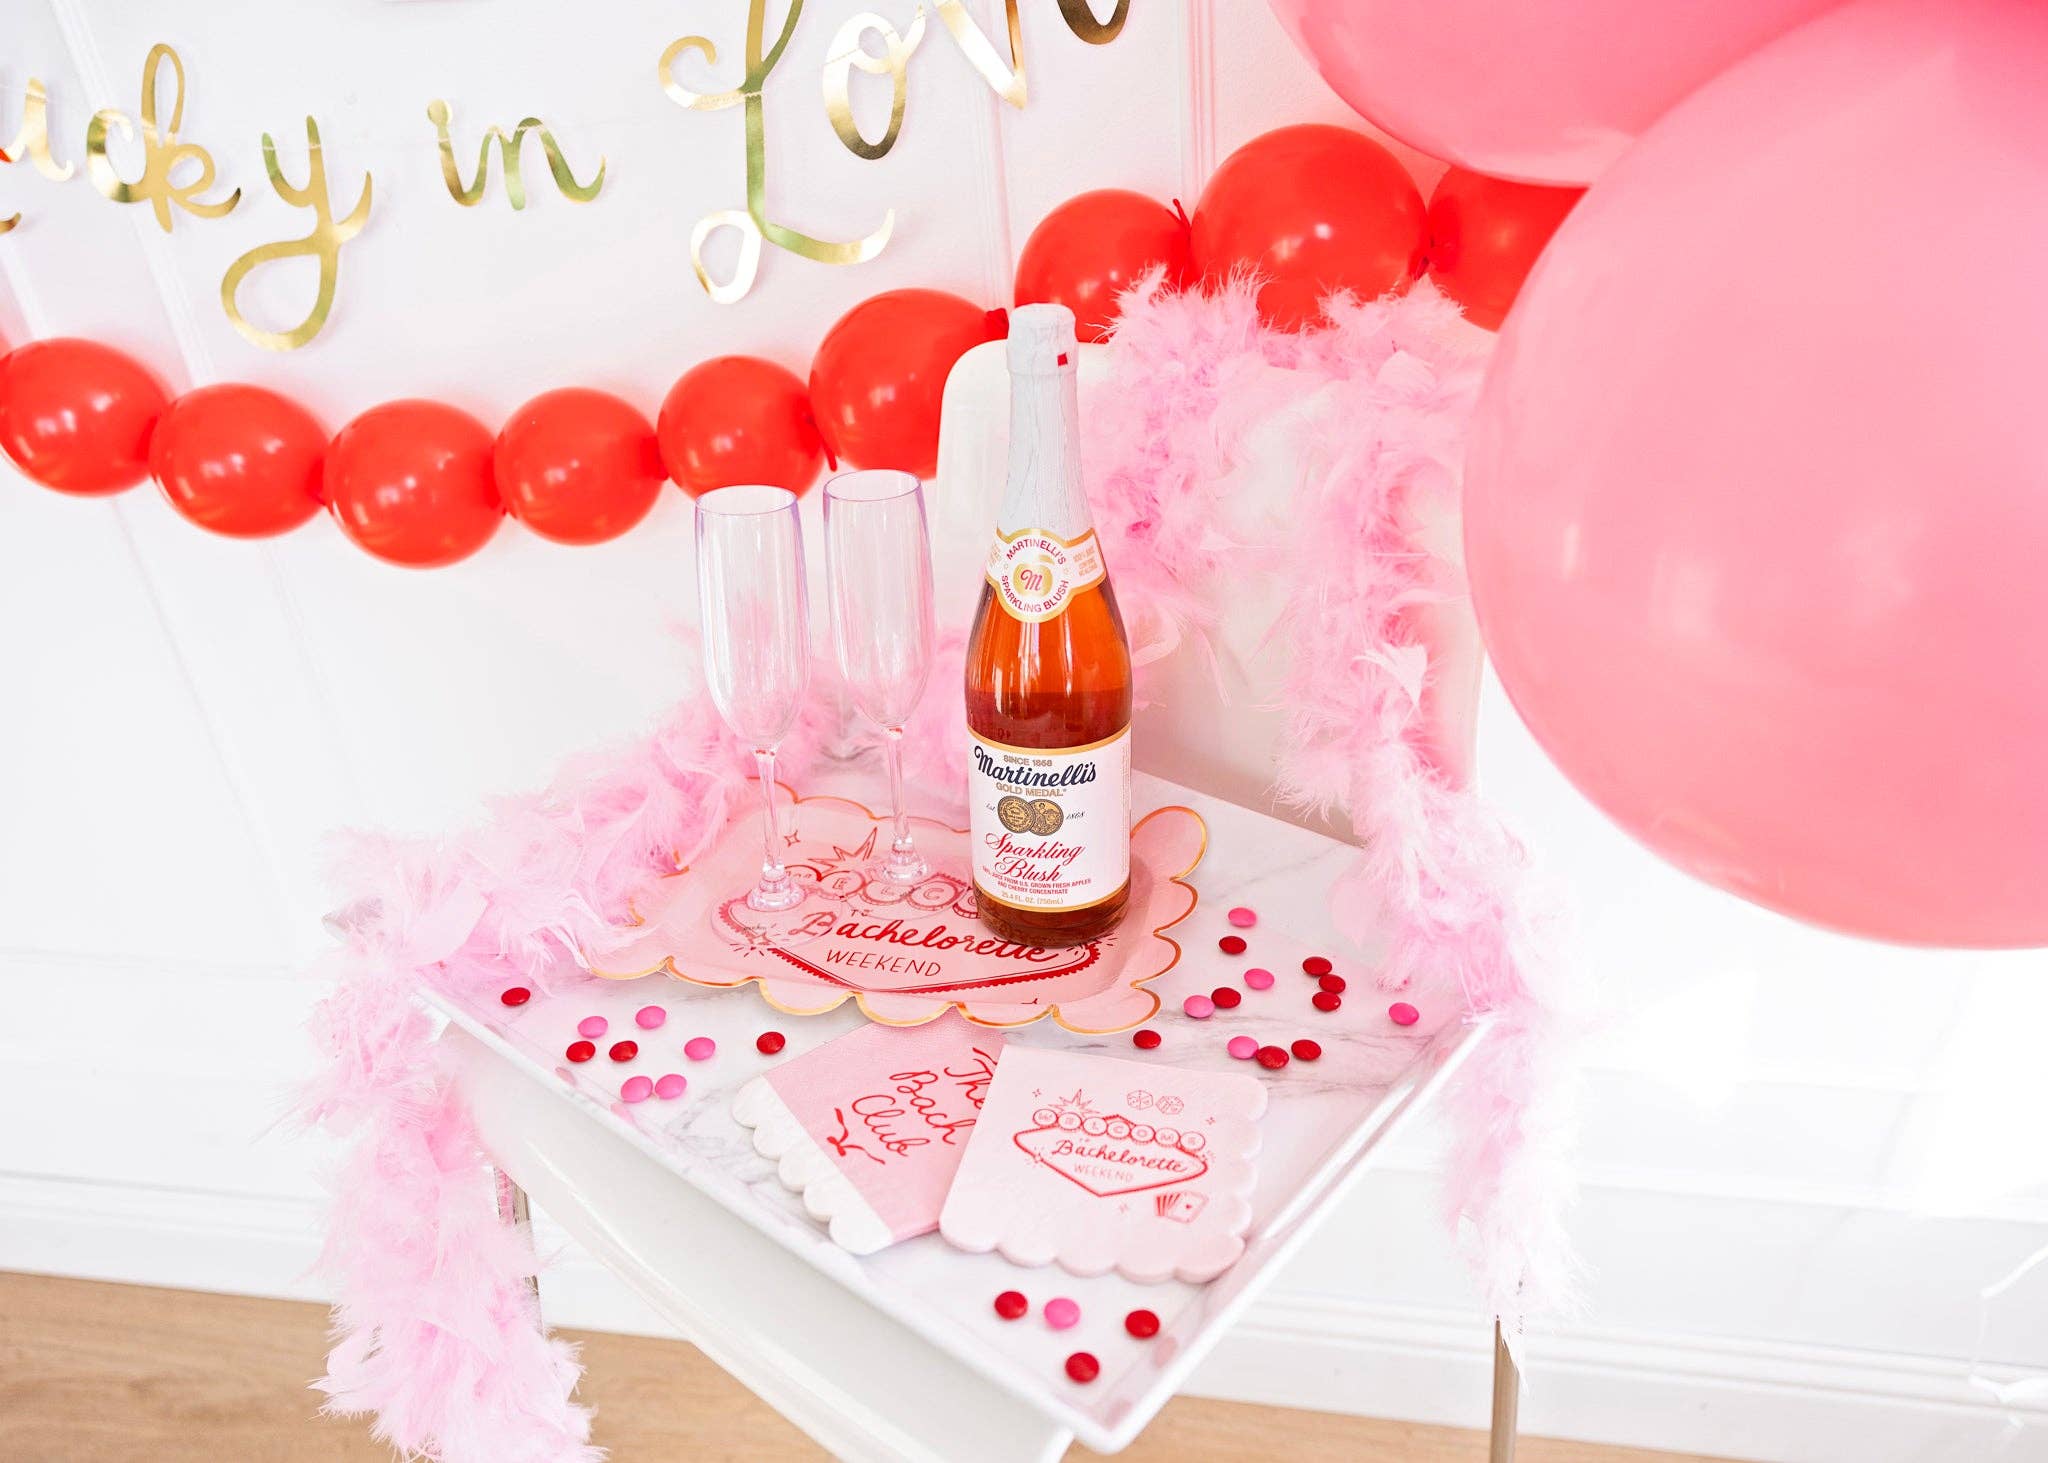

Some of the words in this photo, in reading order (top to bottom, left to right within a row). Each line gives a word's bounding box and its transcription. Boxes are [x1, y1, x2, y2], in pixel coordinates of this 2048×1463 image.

[0, 43, 373, 350] ucky
[427, 99, 606, 210] in
[1006, 538, 1067, 565] MARTINELLI'S
[1001, 575, 1041, 613] SPARKLING
[1043, 580, 1069, 610] BLUSH
[974, 745, 1096, 787] Martinelli's
[1003, 754, 1030, 766] SINCE
[996, 781, 1023, 794] GOLD
[984, 832, 1086, 866] Sparkling
[994, 856, 1063, 882] Blush
[1004, 876, 1018, 885] FROM
[1071, 878, 1092, 887] APPLES
[997, 881, 1007, 889] AND
[1008, 884, 1028, 893] CHERRY
[825, 948, 942, 978] WEEKEND
[889, 1070, 977, 1145] Bach
[852, 1095, 930, 1156] Club
[1036, 1111, 1199, 1146] WELCOME
[1051, 1139, 1188, 1172] Bachelorette
[1073, 1162, 1134, 1183] WEEKEND
